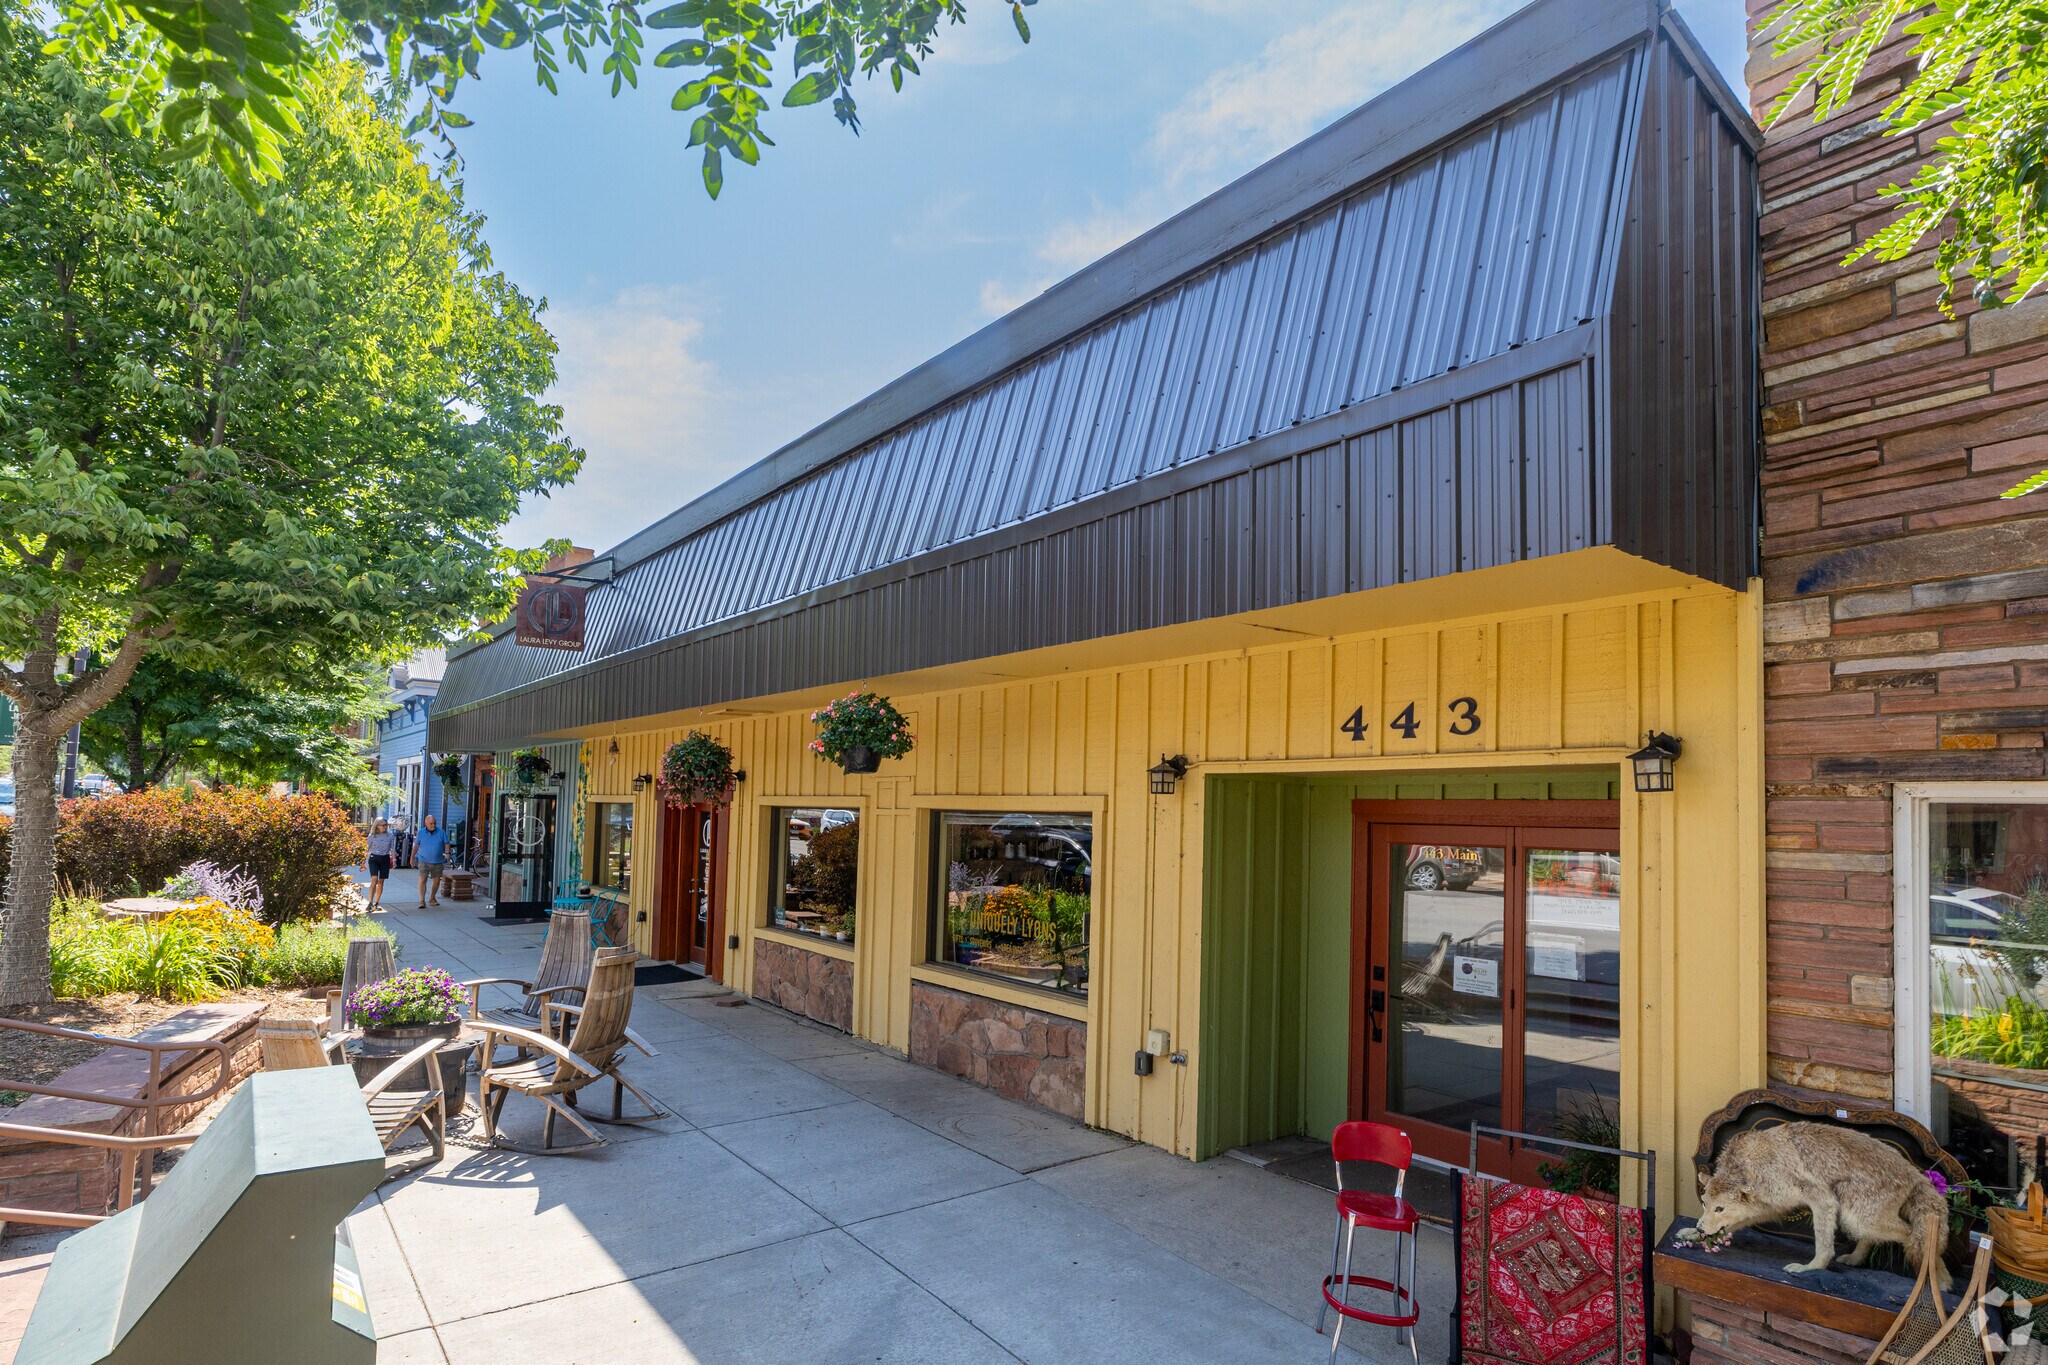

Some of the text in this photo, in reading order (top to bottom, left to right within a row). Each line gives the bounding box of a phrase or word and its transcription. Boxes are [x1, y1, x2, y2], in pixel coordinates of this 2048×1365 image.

[520, 636, 582, 648] LAURA LEVY GROUP
[1340, 696, 1481, 741] 443
[1423, 847, 1479, 861] 443 Main
[1551, 861, 1600, 879] FOR
[970, 911, 1057, 942] UNIQUELY LYONS
